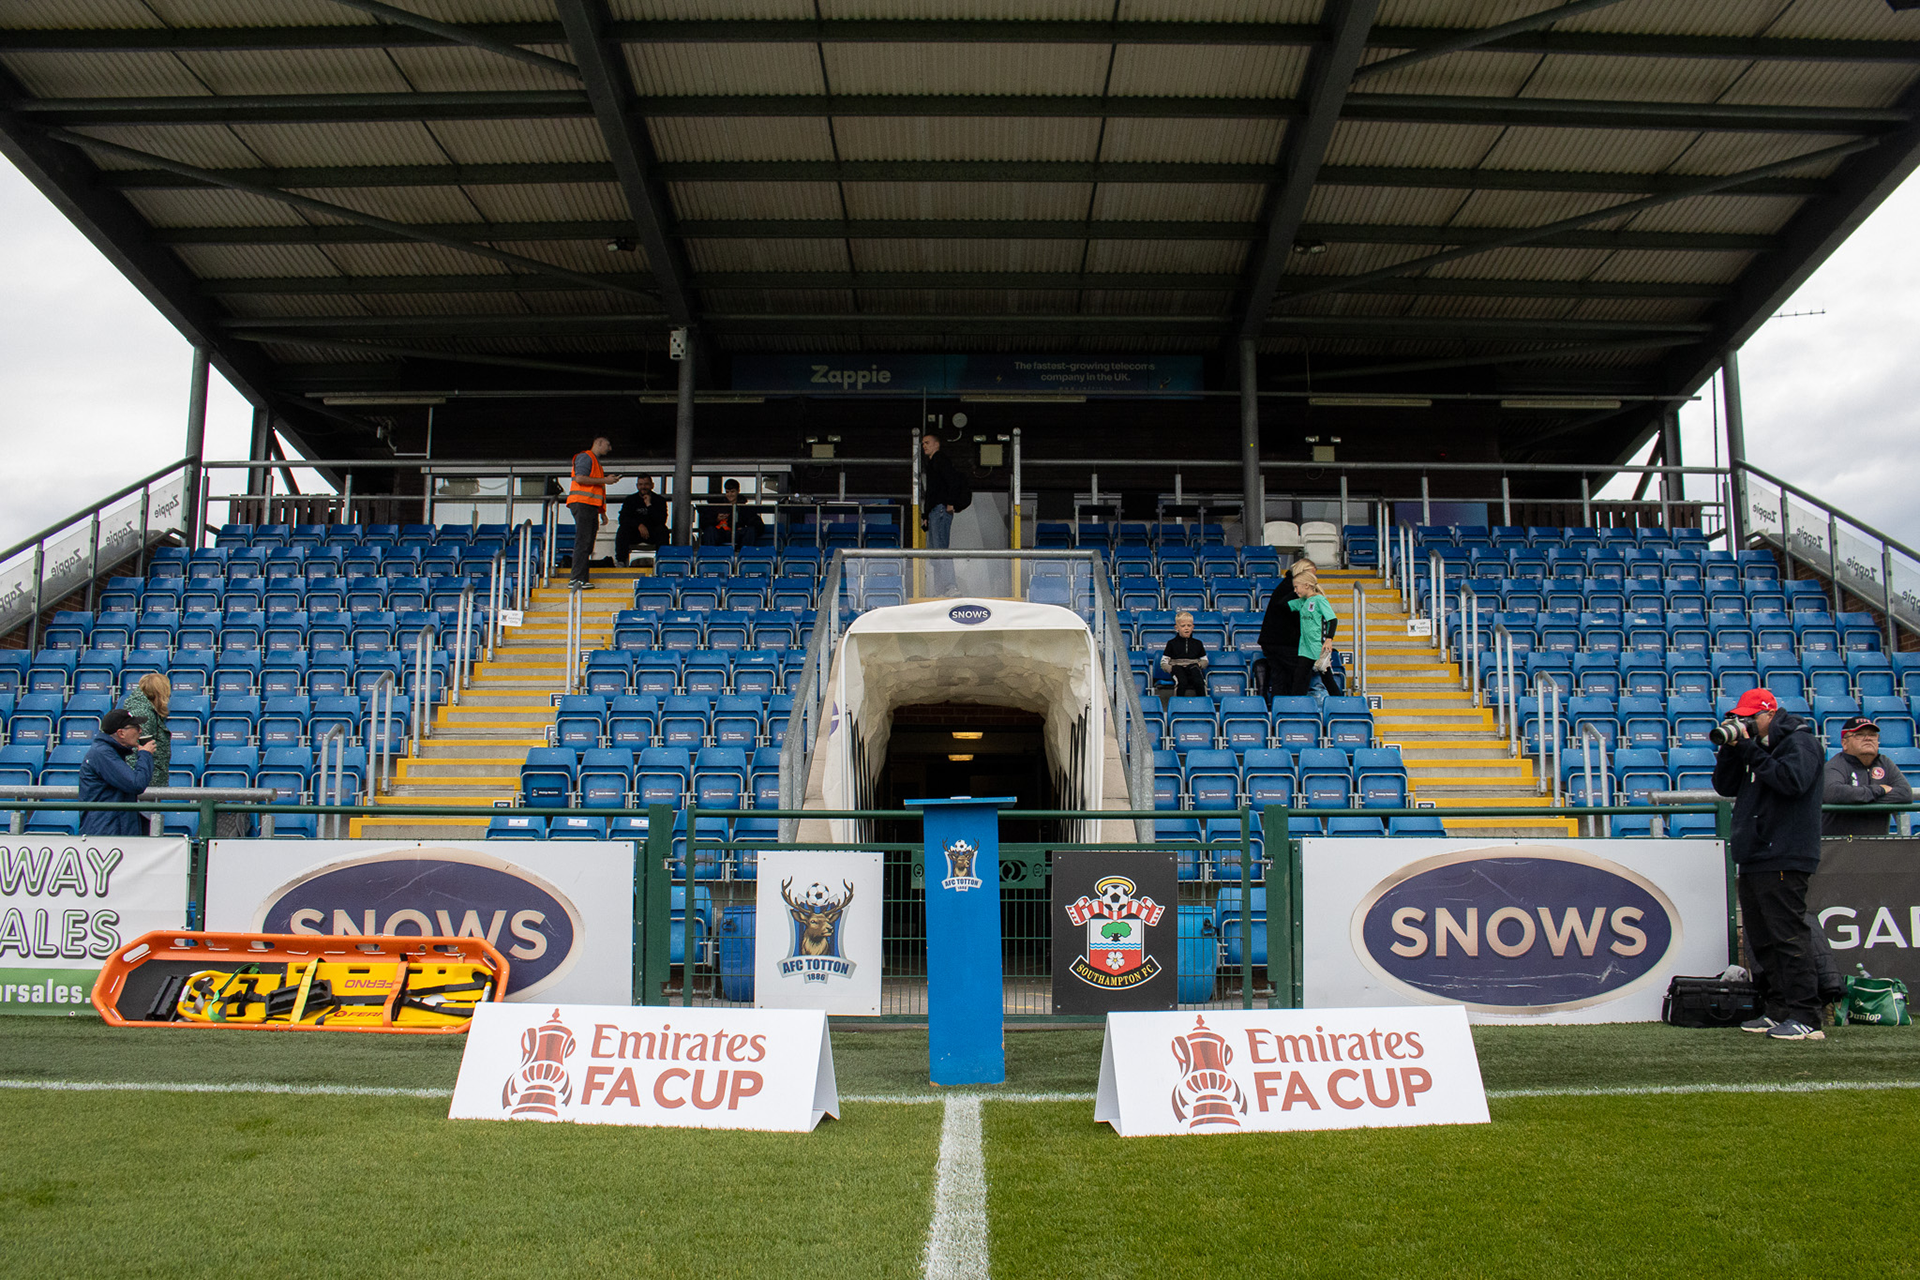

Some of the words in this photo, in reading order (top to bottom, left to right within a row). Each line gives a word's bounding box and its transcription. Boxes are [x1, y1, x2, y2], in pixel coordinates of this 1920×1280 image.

[810, 364, 892, 390] Zappie
[1014, 361, 1032, 370] The
[1033, 361, 1110, 371] fastest-growing
[1111, 361, 1155, 370] telecoms
[1040, 373, 1085, 382] company
[1086, 372, 1096, 381] in
[1097, 372, 1113, 381] the
[1114, 372, 1131, 381] UK.
[952, 610, 988, 618] SNOWS
[1371, 701, 1378, 709] E
[0, 846, 123, 897] WAY
[956, 878, 979, 886] TOTTON
[290, 908, 548, 960] SNOWS
[1389, 906, 1648, 958] SNOWS
[782, 959, 803, 973] AFC
[805, 958, 850, 974] TOTTON
[806, 972, 826, 981] 1886
[1076, 963, 1142, 986] SOUTHAMPTON
[1141, 964, 1154, 977] FC
[344, 979, 395, 988] FERNO
[590, 1023, 767, 1062] Emirates
[1245, 1025, 1424, 1063] Emirates
[580, 1066, 641, 1107] FA
[653, 1067, 764, 1110] CUP
[1253, 1071, 1321, 1112] FA
[1327, 1067, 1432, 1110] CUP
